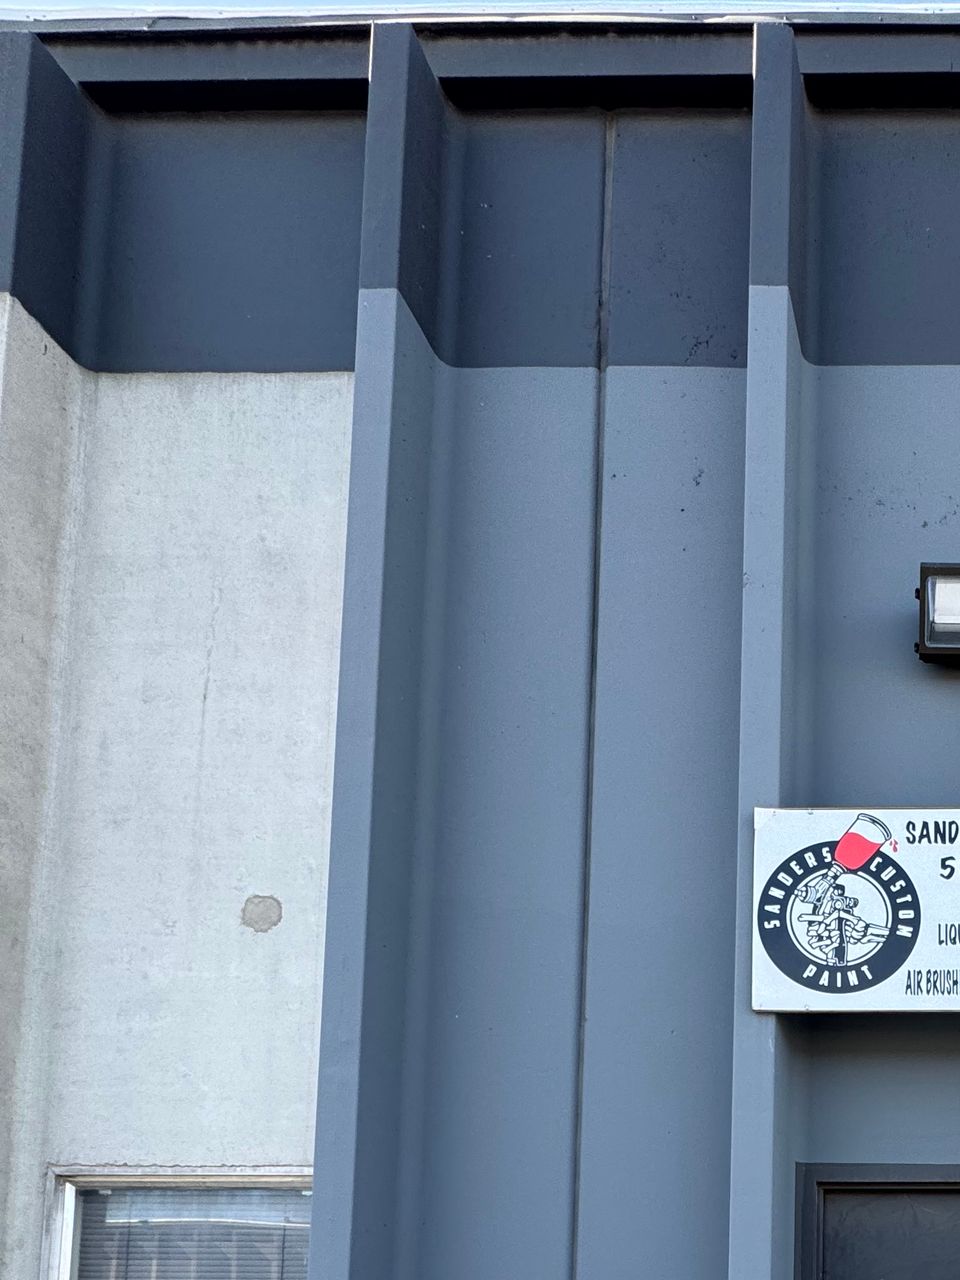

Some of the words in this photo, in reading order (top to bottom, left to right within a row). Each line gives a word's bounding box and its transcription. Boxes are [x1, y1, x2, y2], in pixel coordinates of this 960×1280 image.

[763, 846, 833, 931] SANDERS
[802, 963, 874, 988] PAINT
[905, 968, 923, 996] AIR
